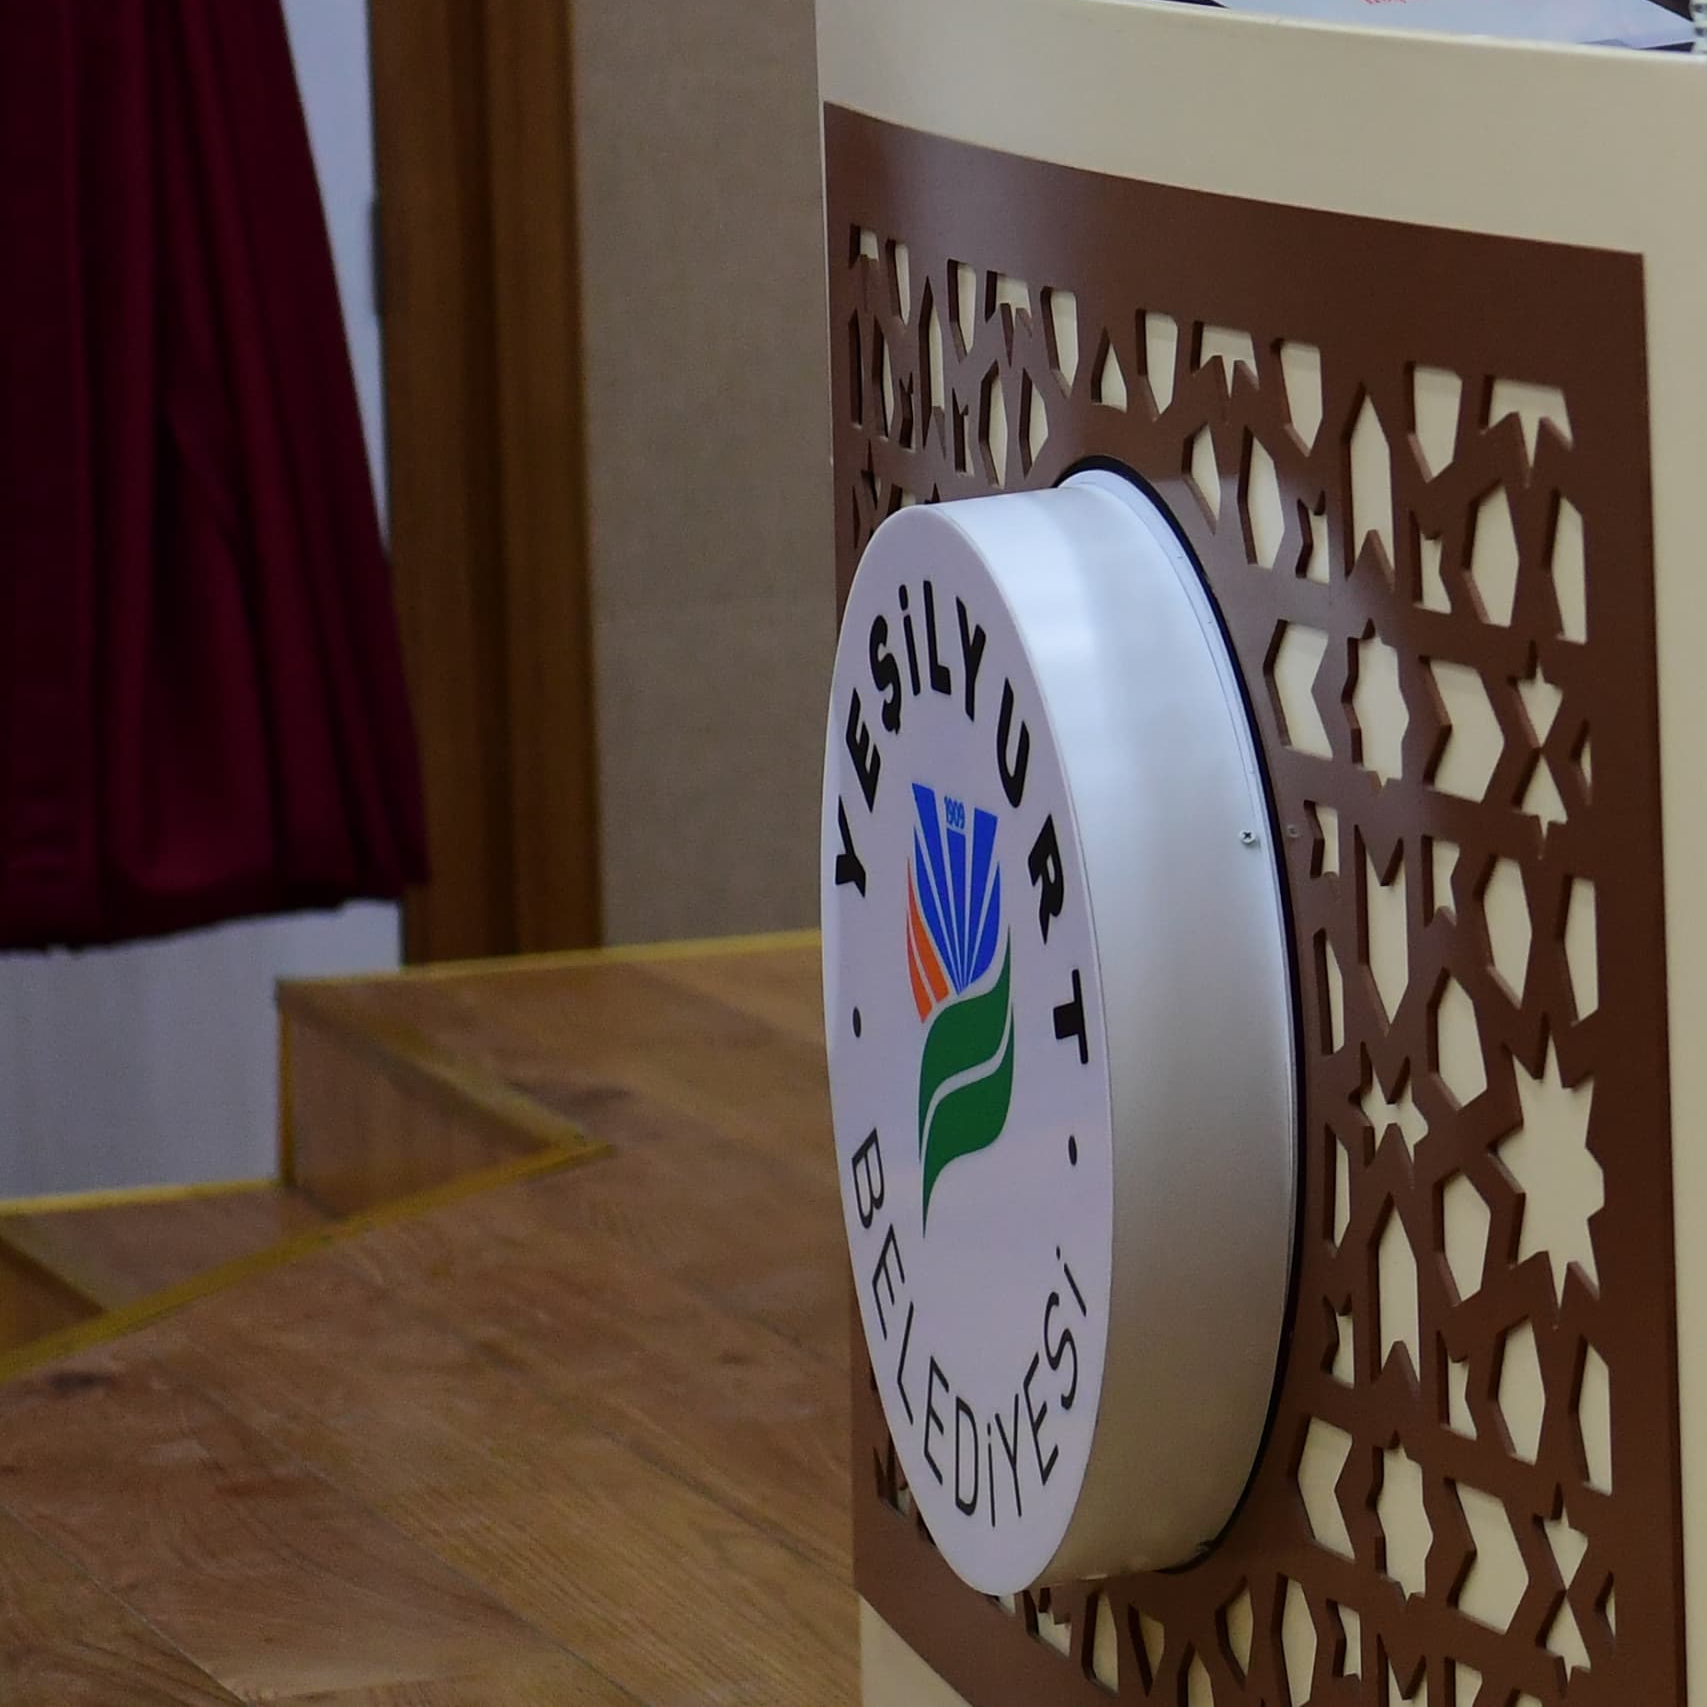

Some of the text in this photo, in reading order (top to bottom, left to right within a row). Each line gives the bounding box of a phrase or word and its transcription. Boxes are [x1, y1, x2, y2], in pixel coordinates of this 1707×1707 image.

[835, 580, 1088, 1064] YEŞİLYURT
[943, 794, 966, 830] 1909
[852, 1128, 1087, 1528] BELEDİYESİ
